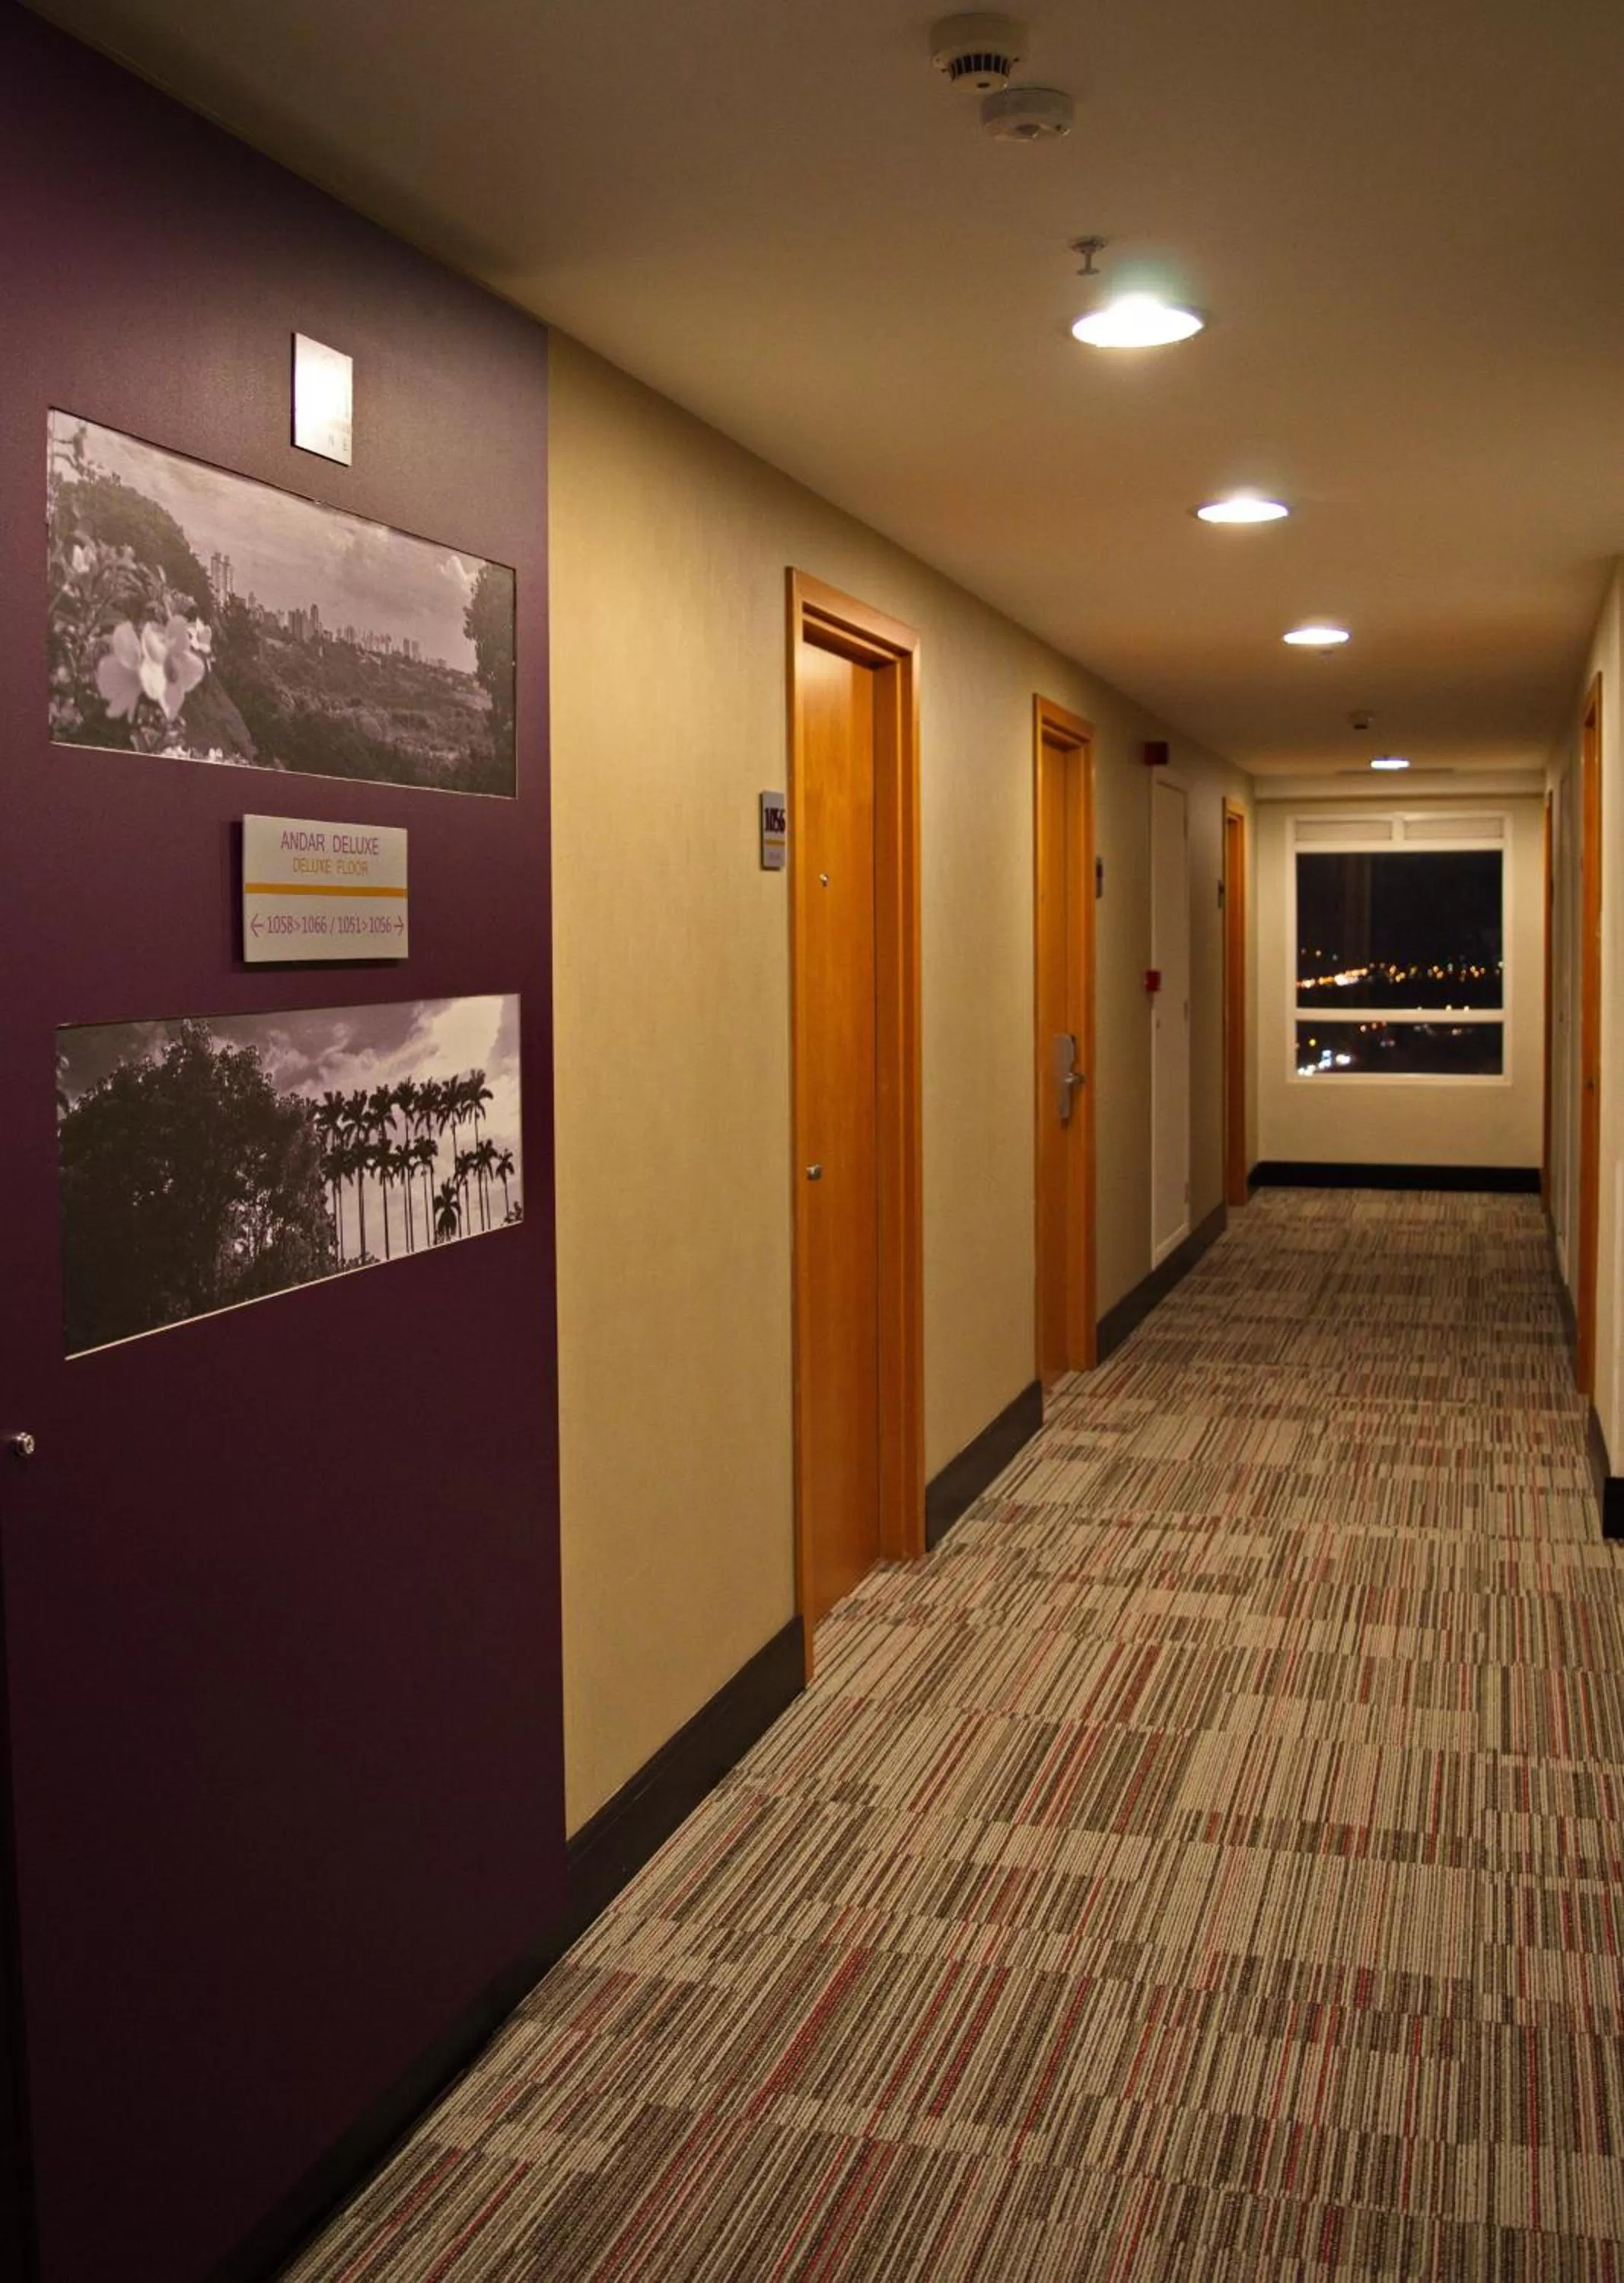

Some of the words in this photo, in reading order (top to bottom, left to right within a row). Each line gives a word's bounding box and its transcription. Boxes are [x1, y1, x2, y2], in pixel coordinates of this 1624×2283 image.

[280, 830, 325, 852] ANDAR
[333, 835, 379, 855] DELUXE
[293, 857, 332, 874] DELUXE
[336, 859, 368, 876] FLOOR
